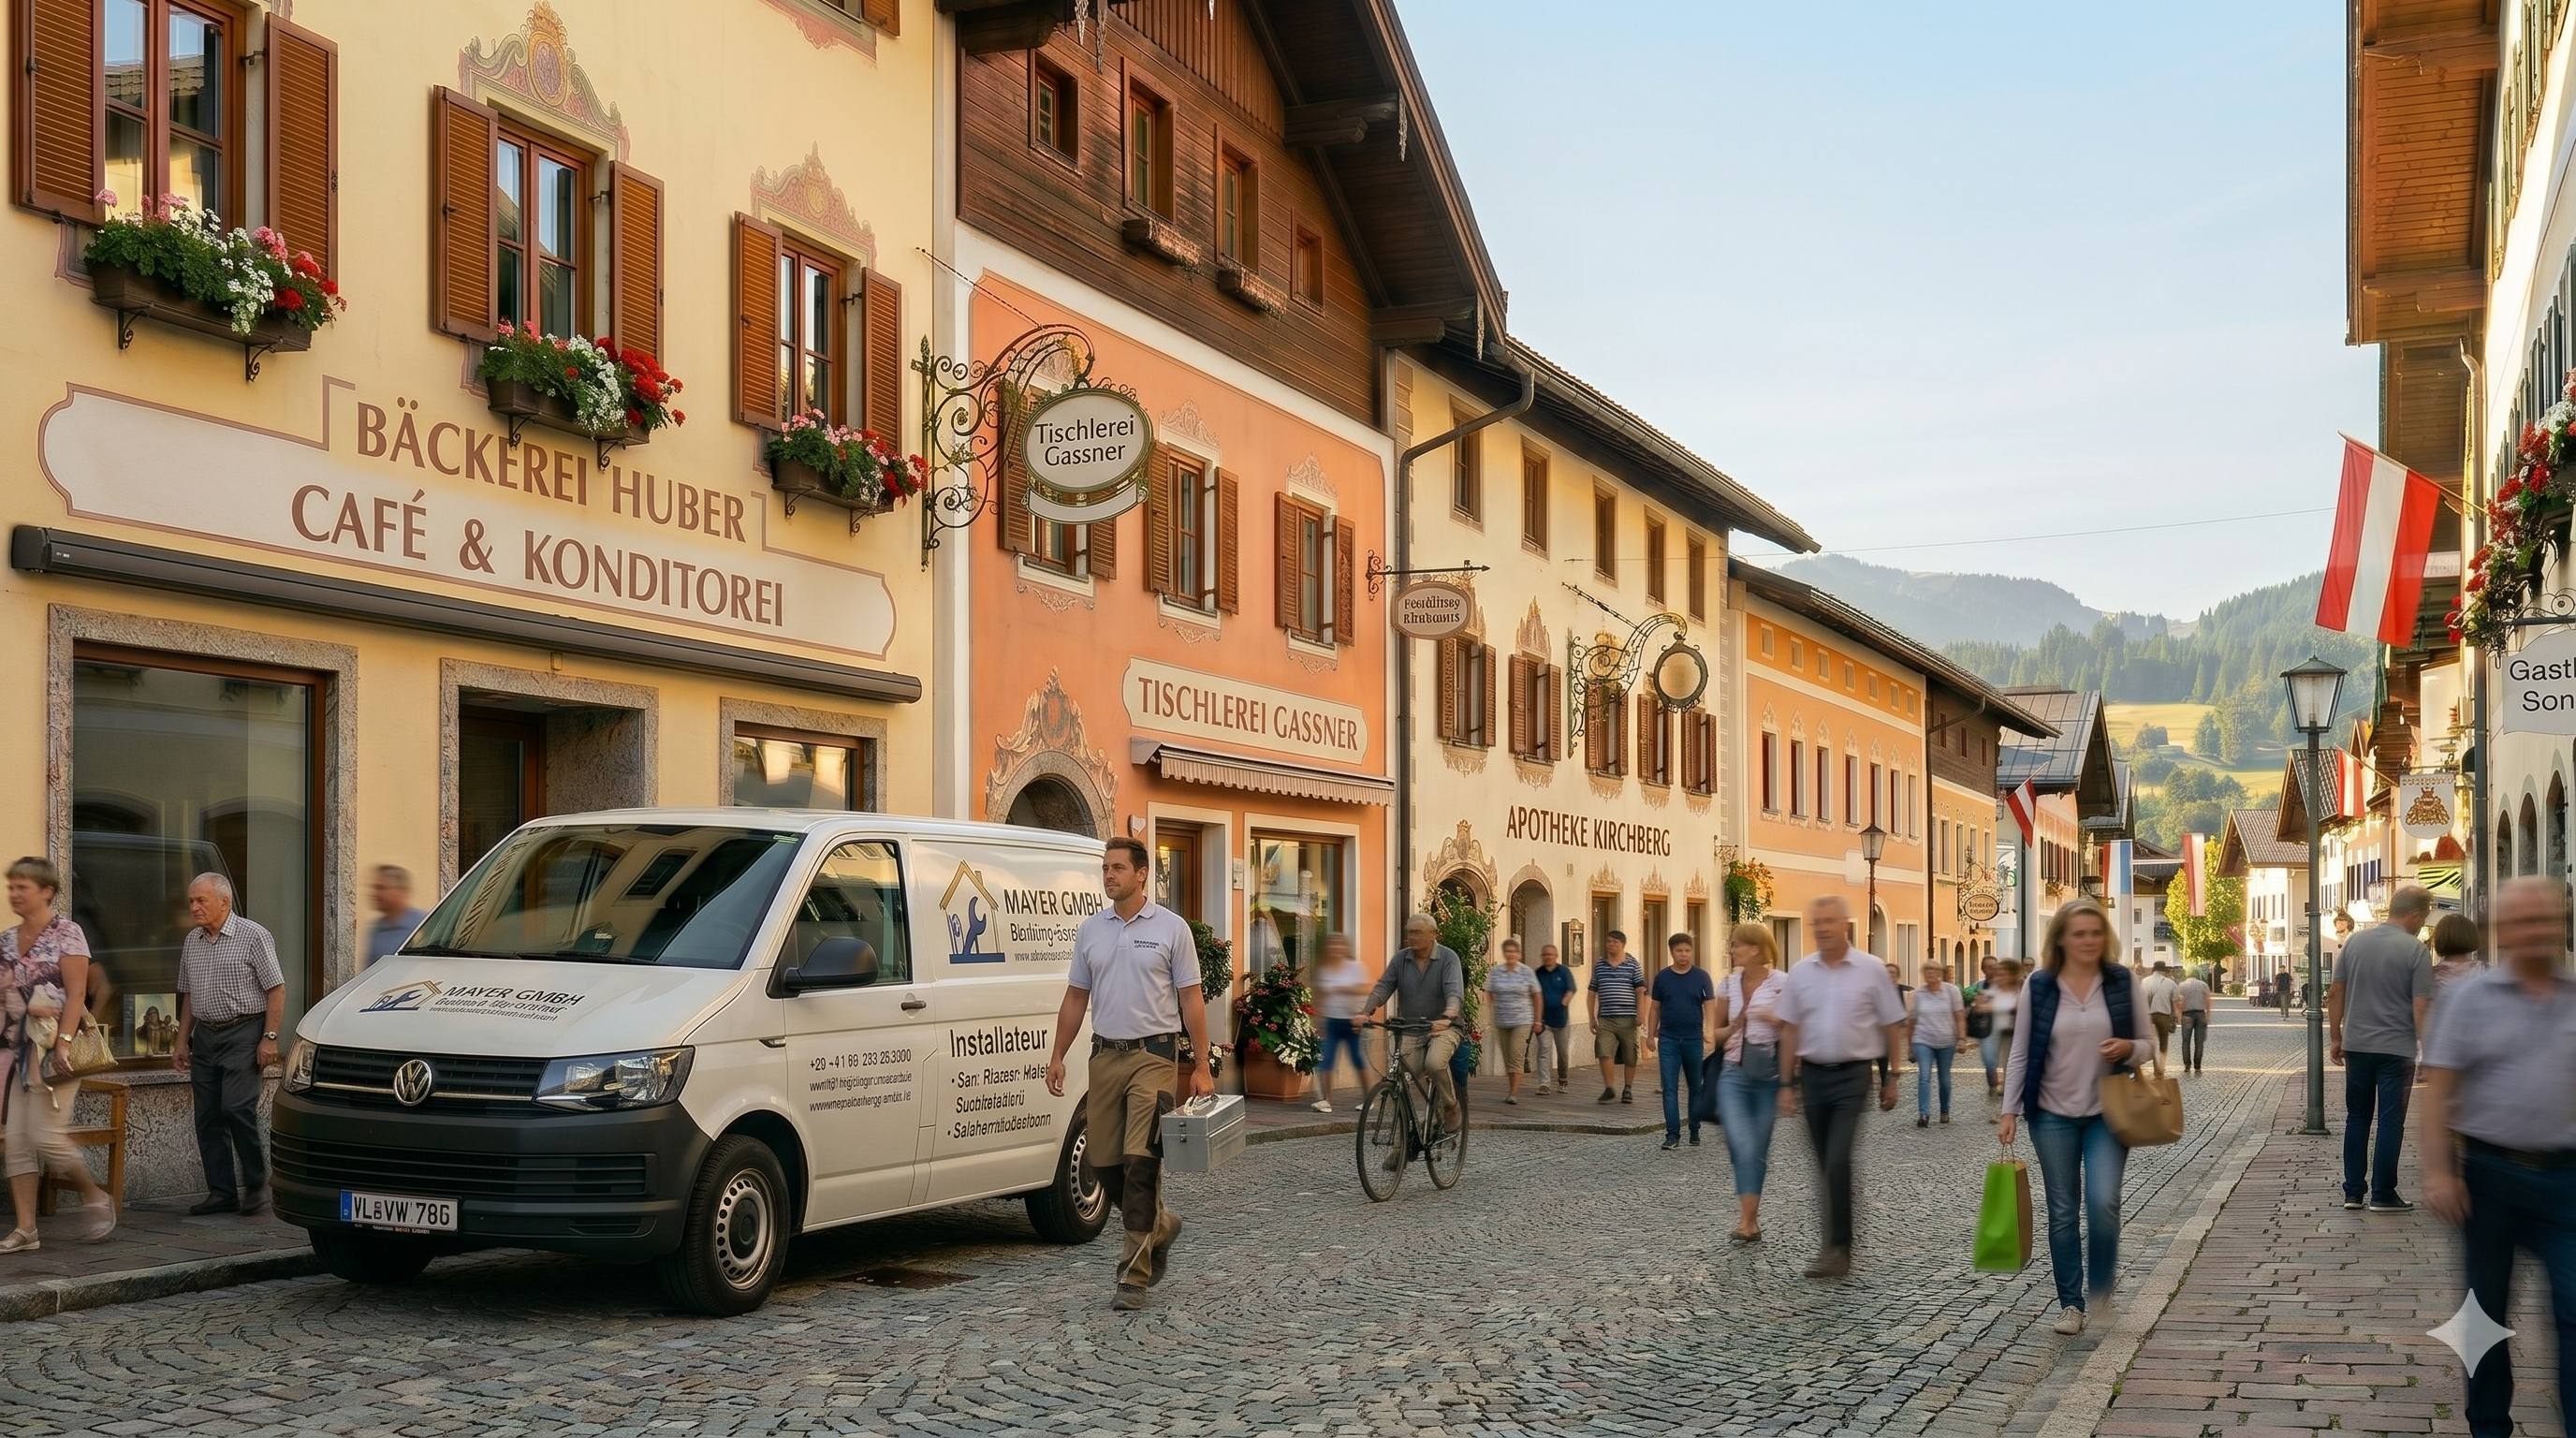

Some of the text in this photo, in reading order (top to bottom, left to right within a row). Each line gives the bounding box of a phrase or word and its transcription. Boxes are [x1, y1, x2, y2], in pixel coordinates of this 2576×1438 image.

[1034, 414, 1134, 445] Tischlerei
[356, 396, 747, 543] BÄCKEREI HUBER
[1044, 444, 1126, 467] Gassner
[290, 483, 784, 628] CAFÉ & KONDITOREI
[2509, 656, 2576, 682] Gast
[1137, 676, 1358, 751] TISCHLEREI GASSNER
[1506, 804, 1672, 858] APOTHEKE KIRCHBERG
[1003, 888, 1059, 916] MAYER
[443, 986, 514, 999] MAYER
[516, 990, 586, 1005] GMBH
[949, 1025, 1047, 1058] Installateur
